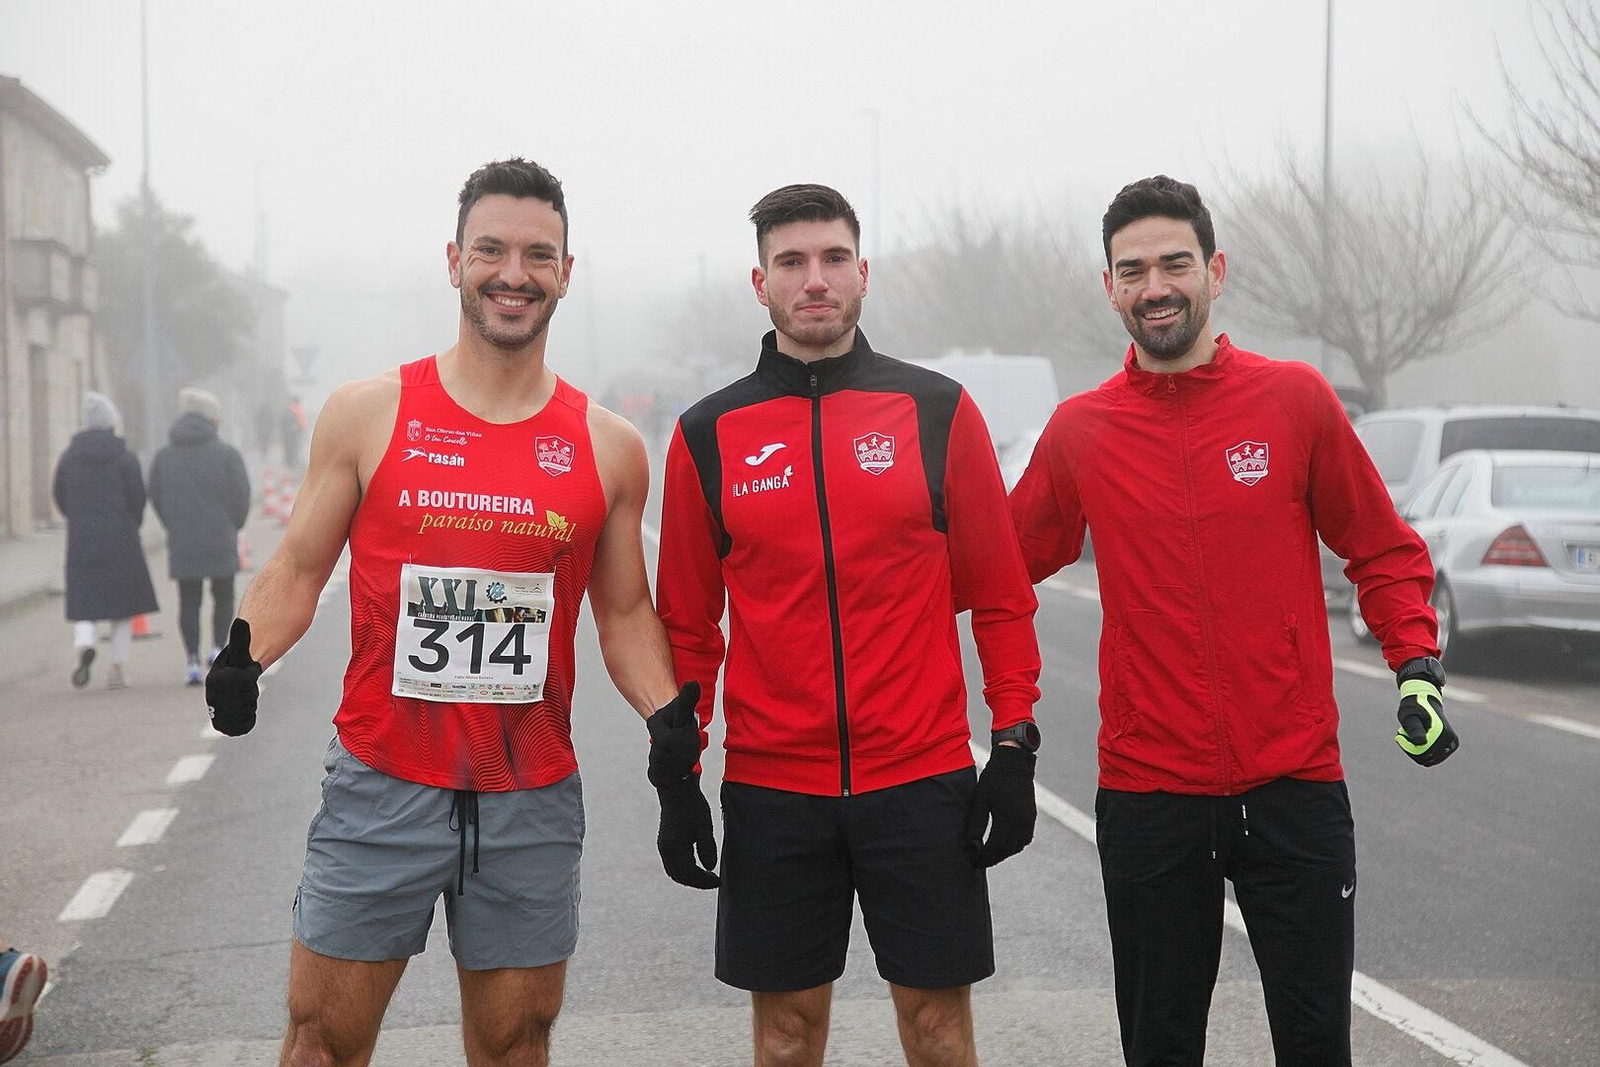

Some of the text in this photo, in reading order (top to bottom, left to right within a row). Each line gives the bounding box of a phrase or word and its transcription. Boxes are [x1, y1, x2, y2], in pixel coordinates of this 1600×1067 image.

[428, 452, 465, 467] rasán
[735, 481, 749, 497] LA
[752, 474, 790, 493] GANGA
[398, 489, 535, 515] A BOUTUREIRA
[417, 512, 577, 543] paraíso natural
[418, 576, 478, 615] XXI
[408, 618, 532, 676] 314
